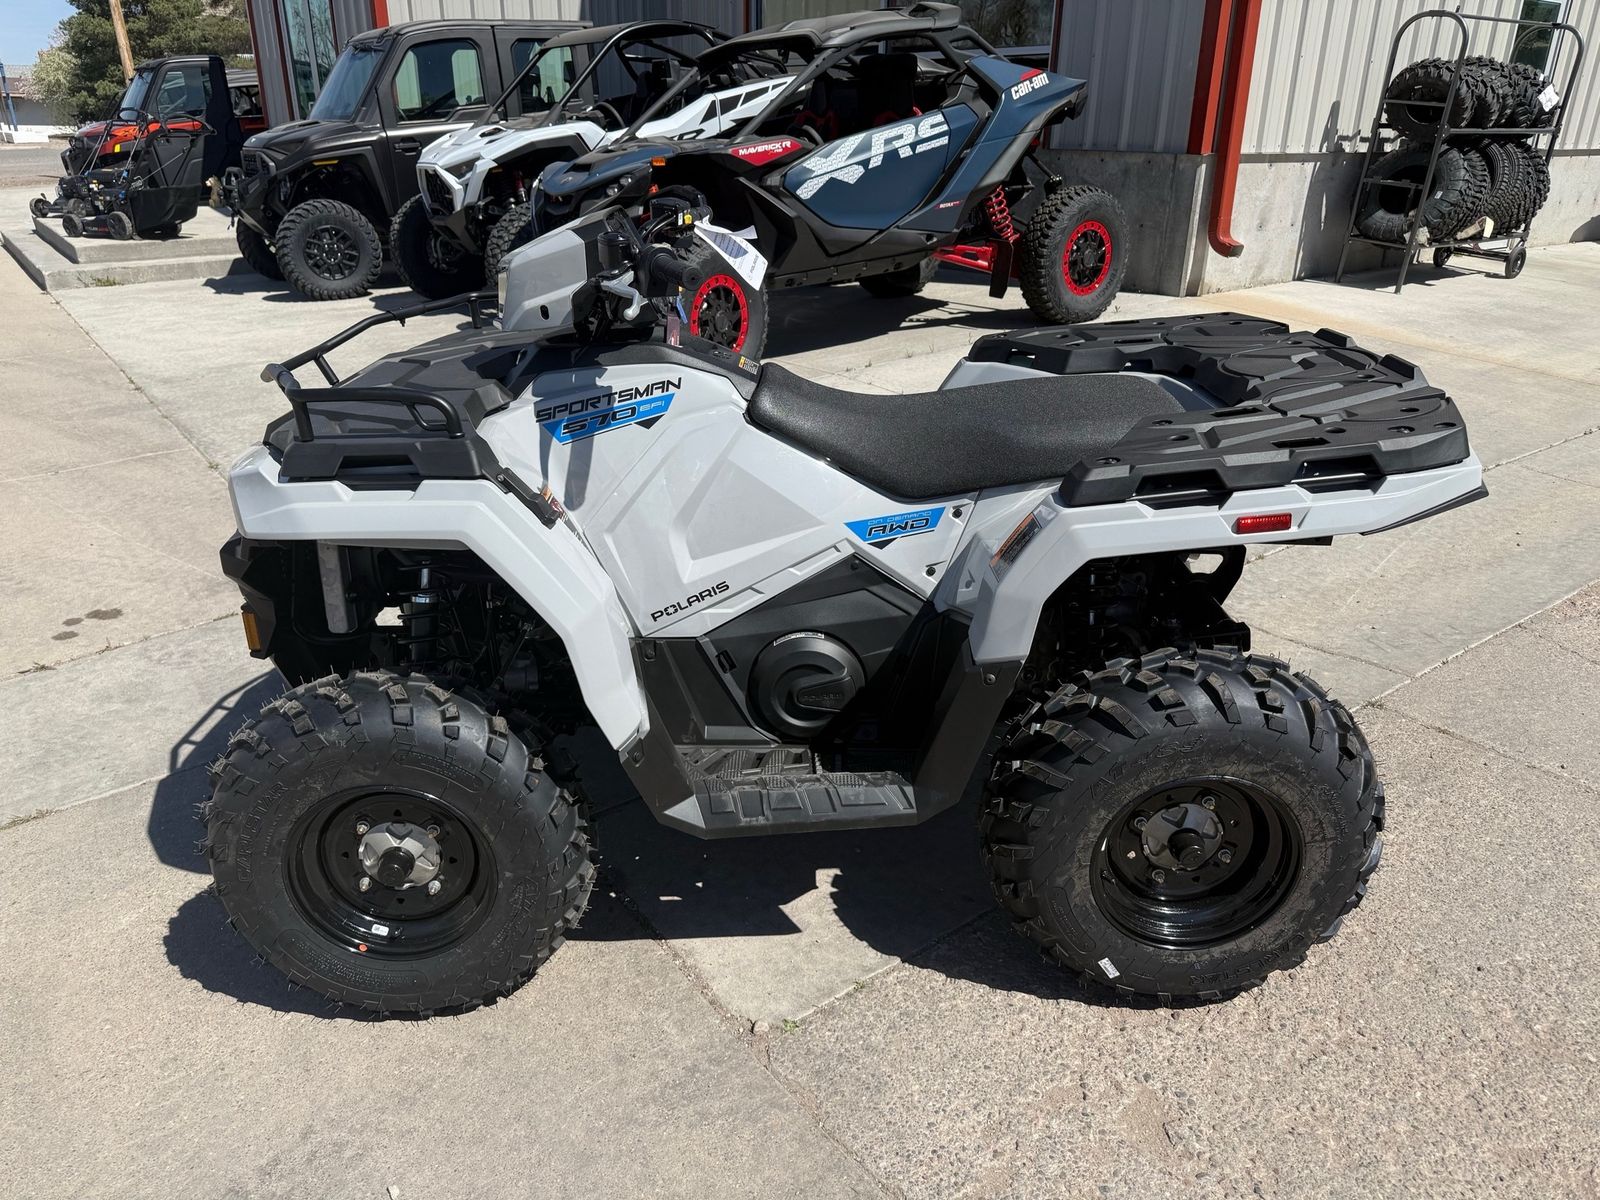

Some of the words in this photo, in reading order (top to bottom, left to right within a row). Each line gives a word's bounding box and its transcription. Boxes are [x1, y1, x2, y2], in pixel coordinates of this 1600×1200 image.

[1010, 72, 1050, 101] can-am
[738, 142, 782, 156] MAVERICK
[796, 112, 950, 201] XRS
[536, 376, 682, 423] SPORTSMAN
[561, 404, 637, 437] 570
[639, 399, 665, 415] EFI
[866, 517, 931, 538] AWD
[867, 518, 883, 526] ON
[887, 510, 932, 523] DEMAND
[650, 580, 730, 622] POLARIS
